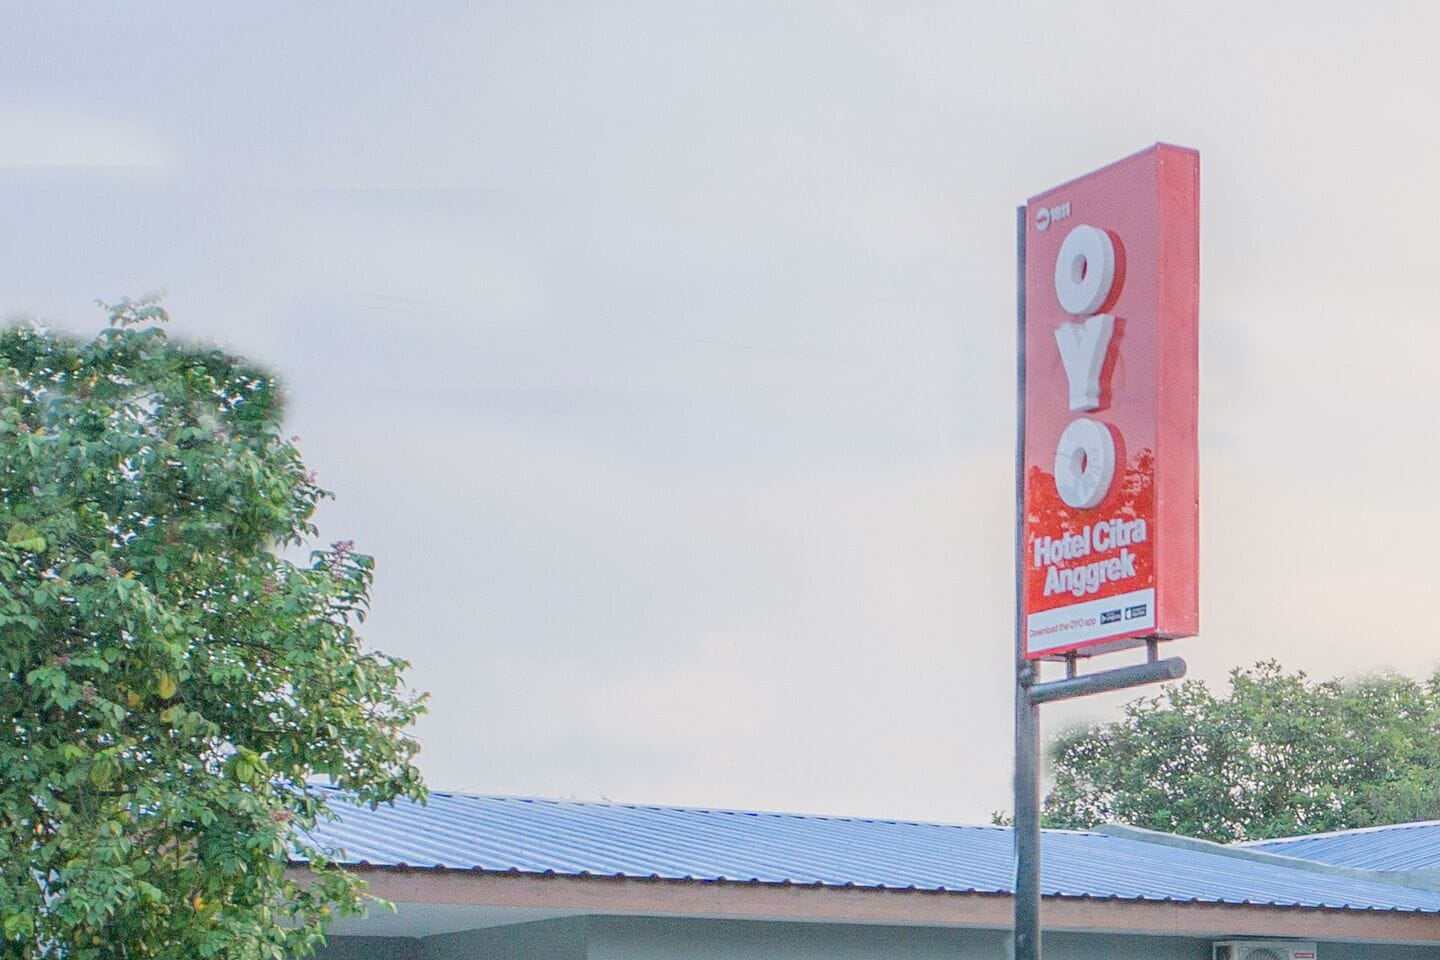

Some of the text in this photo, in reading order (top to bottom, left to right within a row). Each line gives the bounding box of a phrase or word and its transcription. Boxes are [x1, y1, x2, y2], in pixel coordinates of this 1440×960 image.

[1054, 223, 1118, 510] OYO
[1034, 518, 1147, 567] Hotel Citra
[1043, 548, 1136, 597] Anggrek
